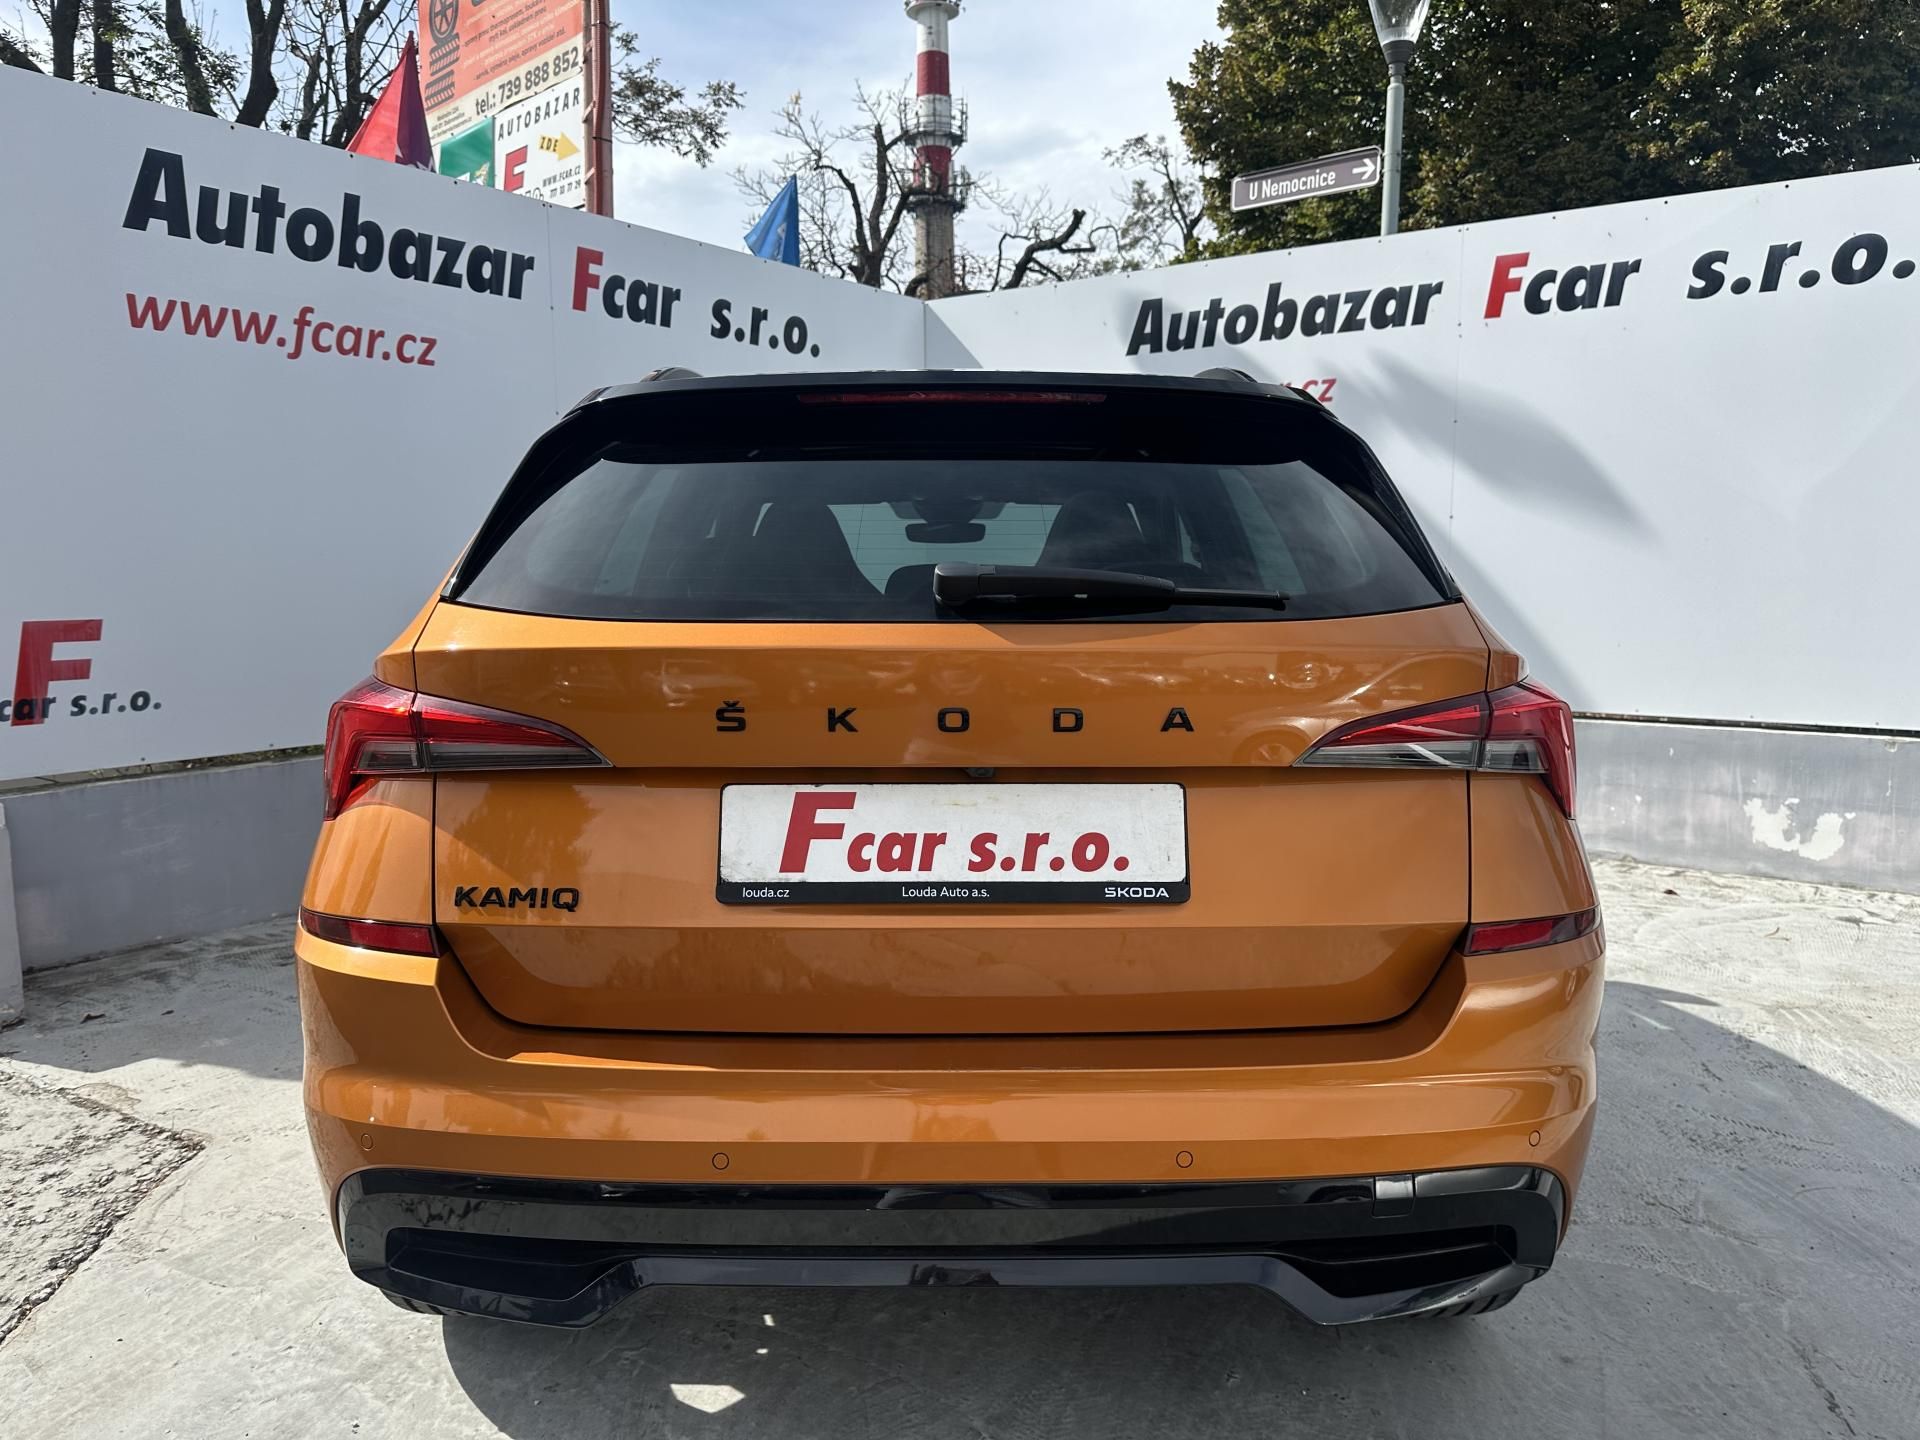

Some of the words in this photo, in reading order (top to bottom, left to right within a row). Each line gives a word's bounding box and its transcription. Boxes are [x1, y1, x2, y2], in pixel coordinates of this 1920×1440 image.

[498, 76, 522, 104] 739
[524, 61, 550, 91] 888
[553, 46, 579, 77] 852
[497, 87, 581, 141] AUTOBAZAR
[540, 136, 559, 153] ZDE
[1249, 182, 1259, 200] U
[1261, 168, 1336, 200] Nemocnice
[122, 147, 535, 300] Autobazar
[572, 246, 682, 329] Fcar
[710, 298, 821, 358] s.r.o.
[1126, 281, 1444, 356] Autobazar
[1484, 252, 1642, 320] Fcar
[1686, 233, 1916, 300] s.r.o.
[126, 293, 438, 367] www.fcar.cz
[11, 619, 103, 727] F
[70, 691, 162, 717] s.r.o.
[715, 701, 1195, 733] ŠKODA
[779, 791, 946, 873] Fcar
[967, 831, 1129, 873] s.r.o.
[454, 886, 580, 913] KAMIQ
[742, 886, 790, 898] louda.cz
[902, 886, 937, 898] Louda
[939, 886, 969, 898] Auto
[971, 888, 990, 898] a.s.
